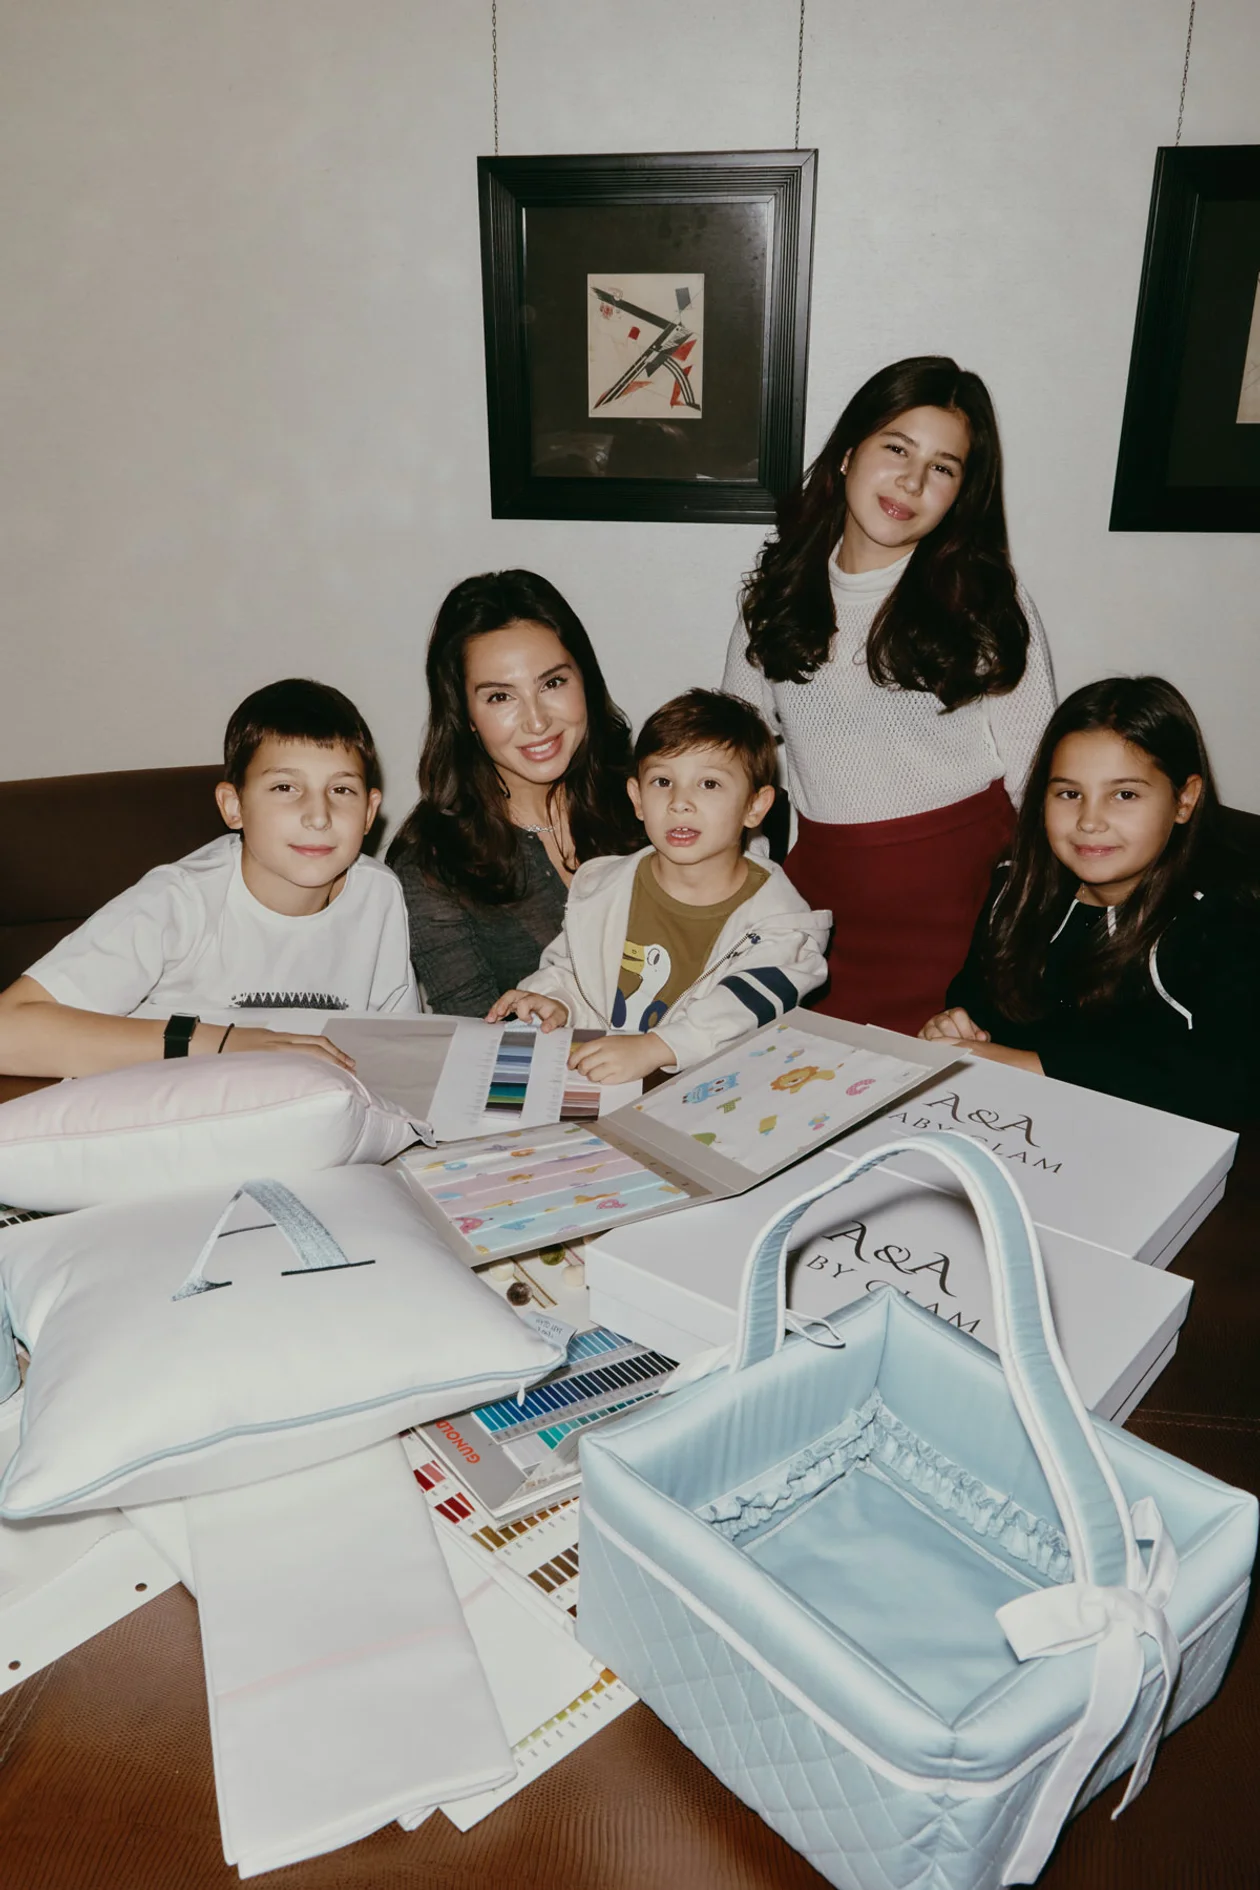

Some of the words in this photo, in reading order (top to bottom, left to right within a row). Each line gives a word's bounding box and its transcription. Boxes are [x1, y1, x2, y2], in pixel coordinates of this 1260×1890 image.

[888, 1111, 956, 1131] ABY
[970, 1134, 1063, 1174] LAM
[922, 1091, 1041, 1148] A&A
[806, 1254, 857, 1279] BY
[822, 1220, 957, 1298] A&A
[434, 1419, 481, 1464] GUNOLD
